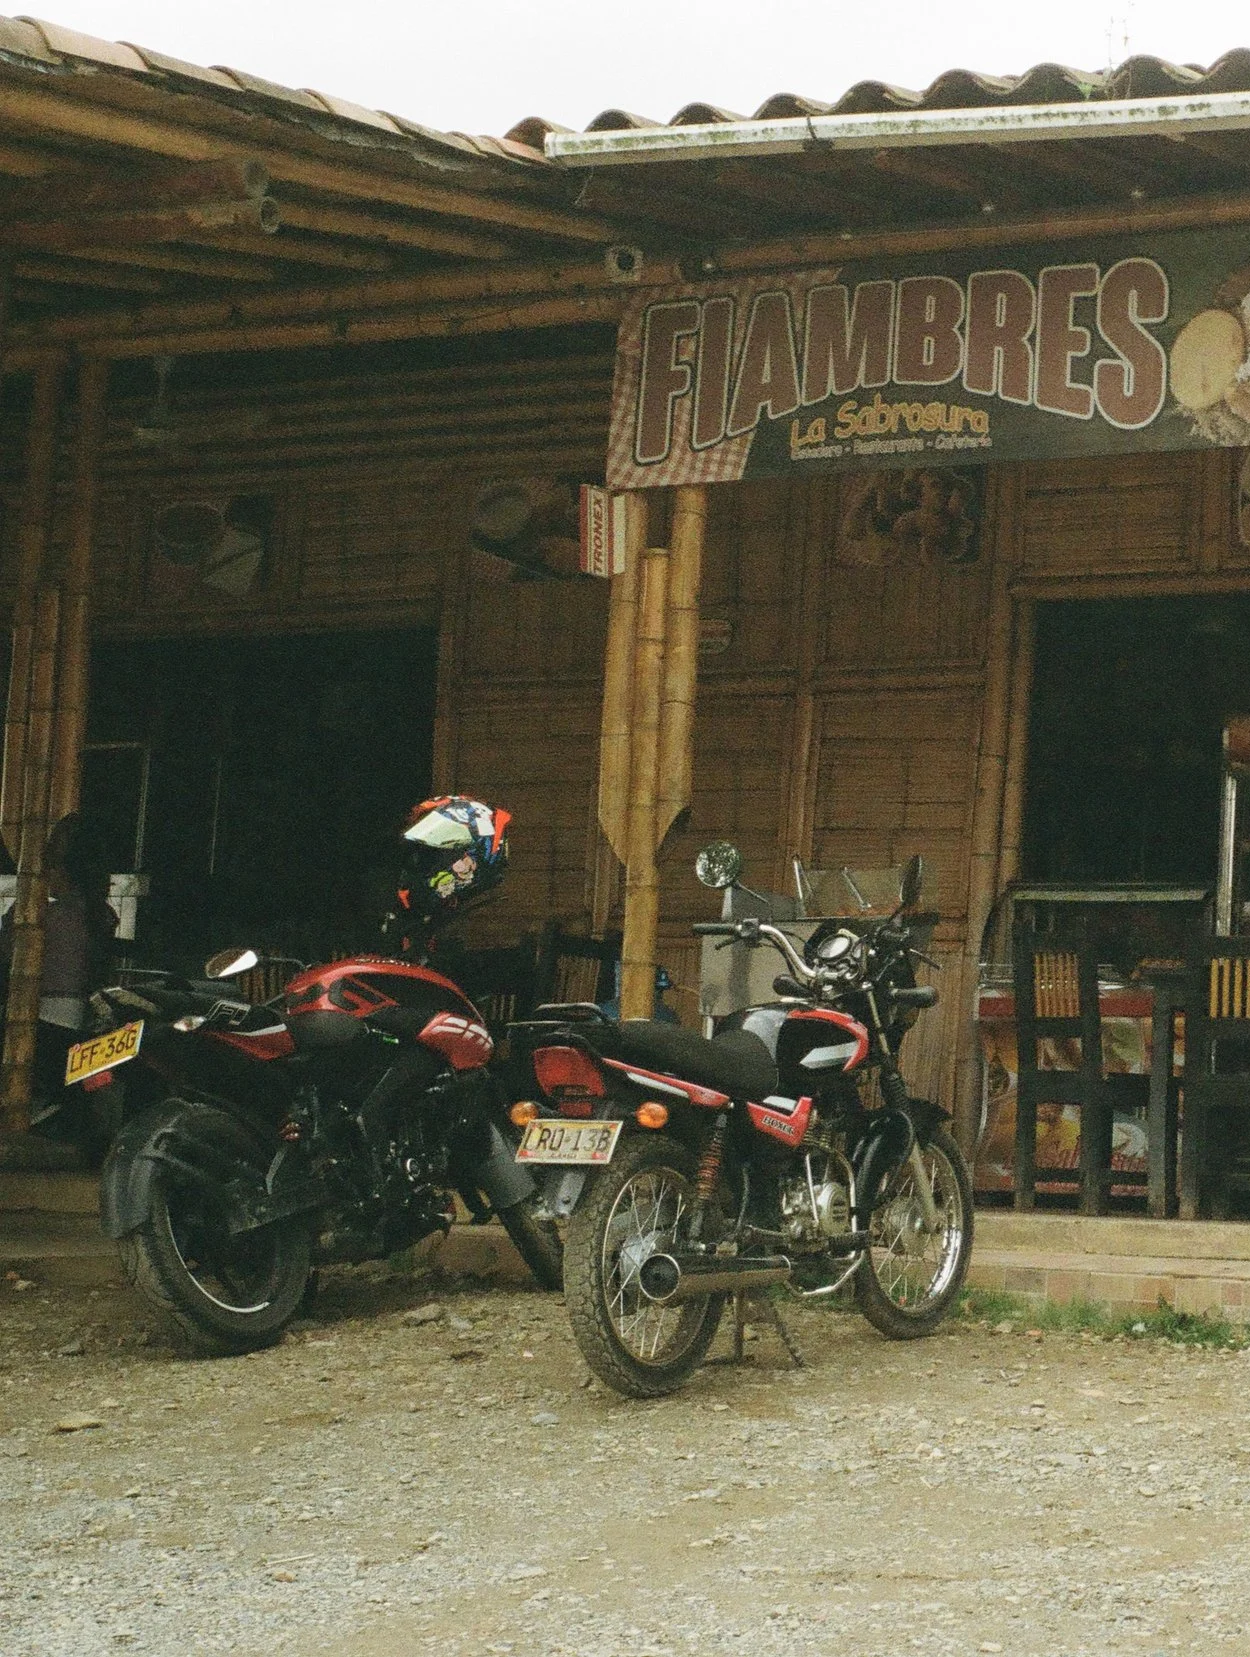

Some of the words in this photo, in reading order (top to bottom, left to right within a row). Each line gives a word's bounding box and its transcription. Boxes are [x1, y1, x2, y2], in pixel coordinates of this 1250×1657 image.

[635, 257, 1169, 465] FIAMBRES
[790, 417, 827, 449] La
[834, 392, 990, 439] Sabrosura
[592, 496, 603, 573] TRONEX
